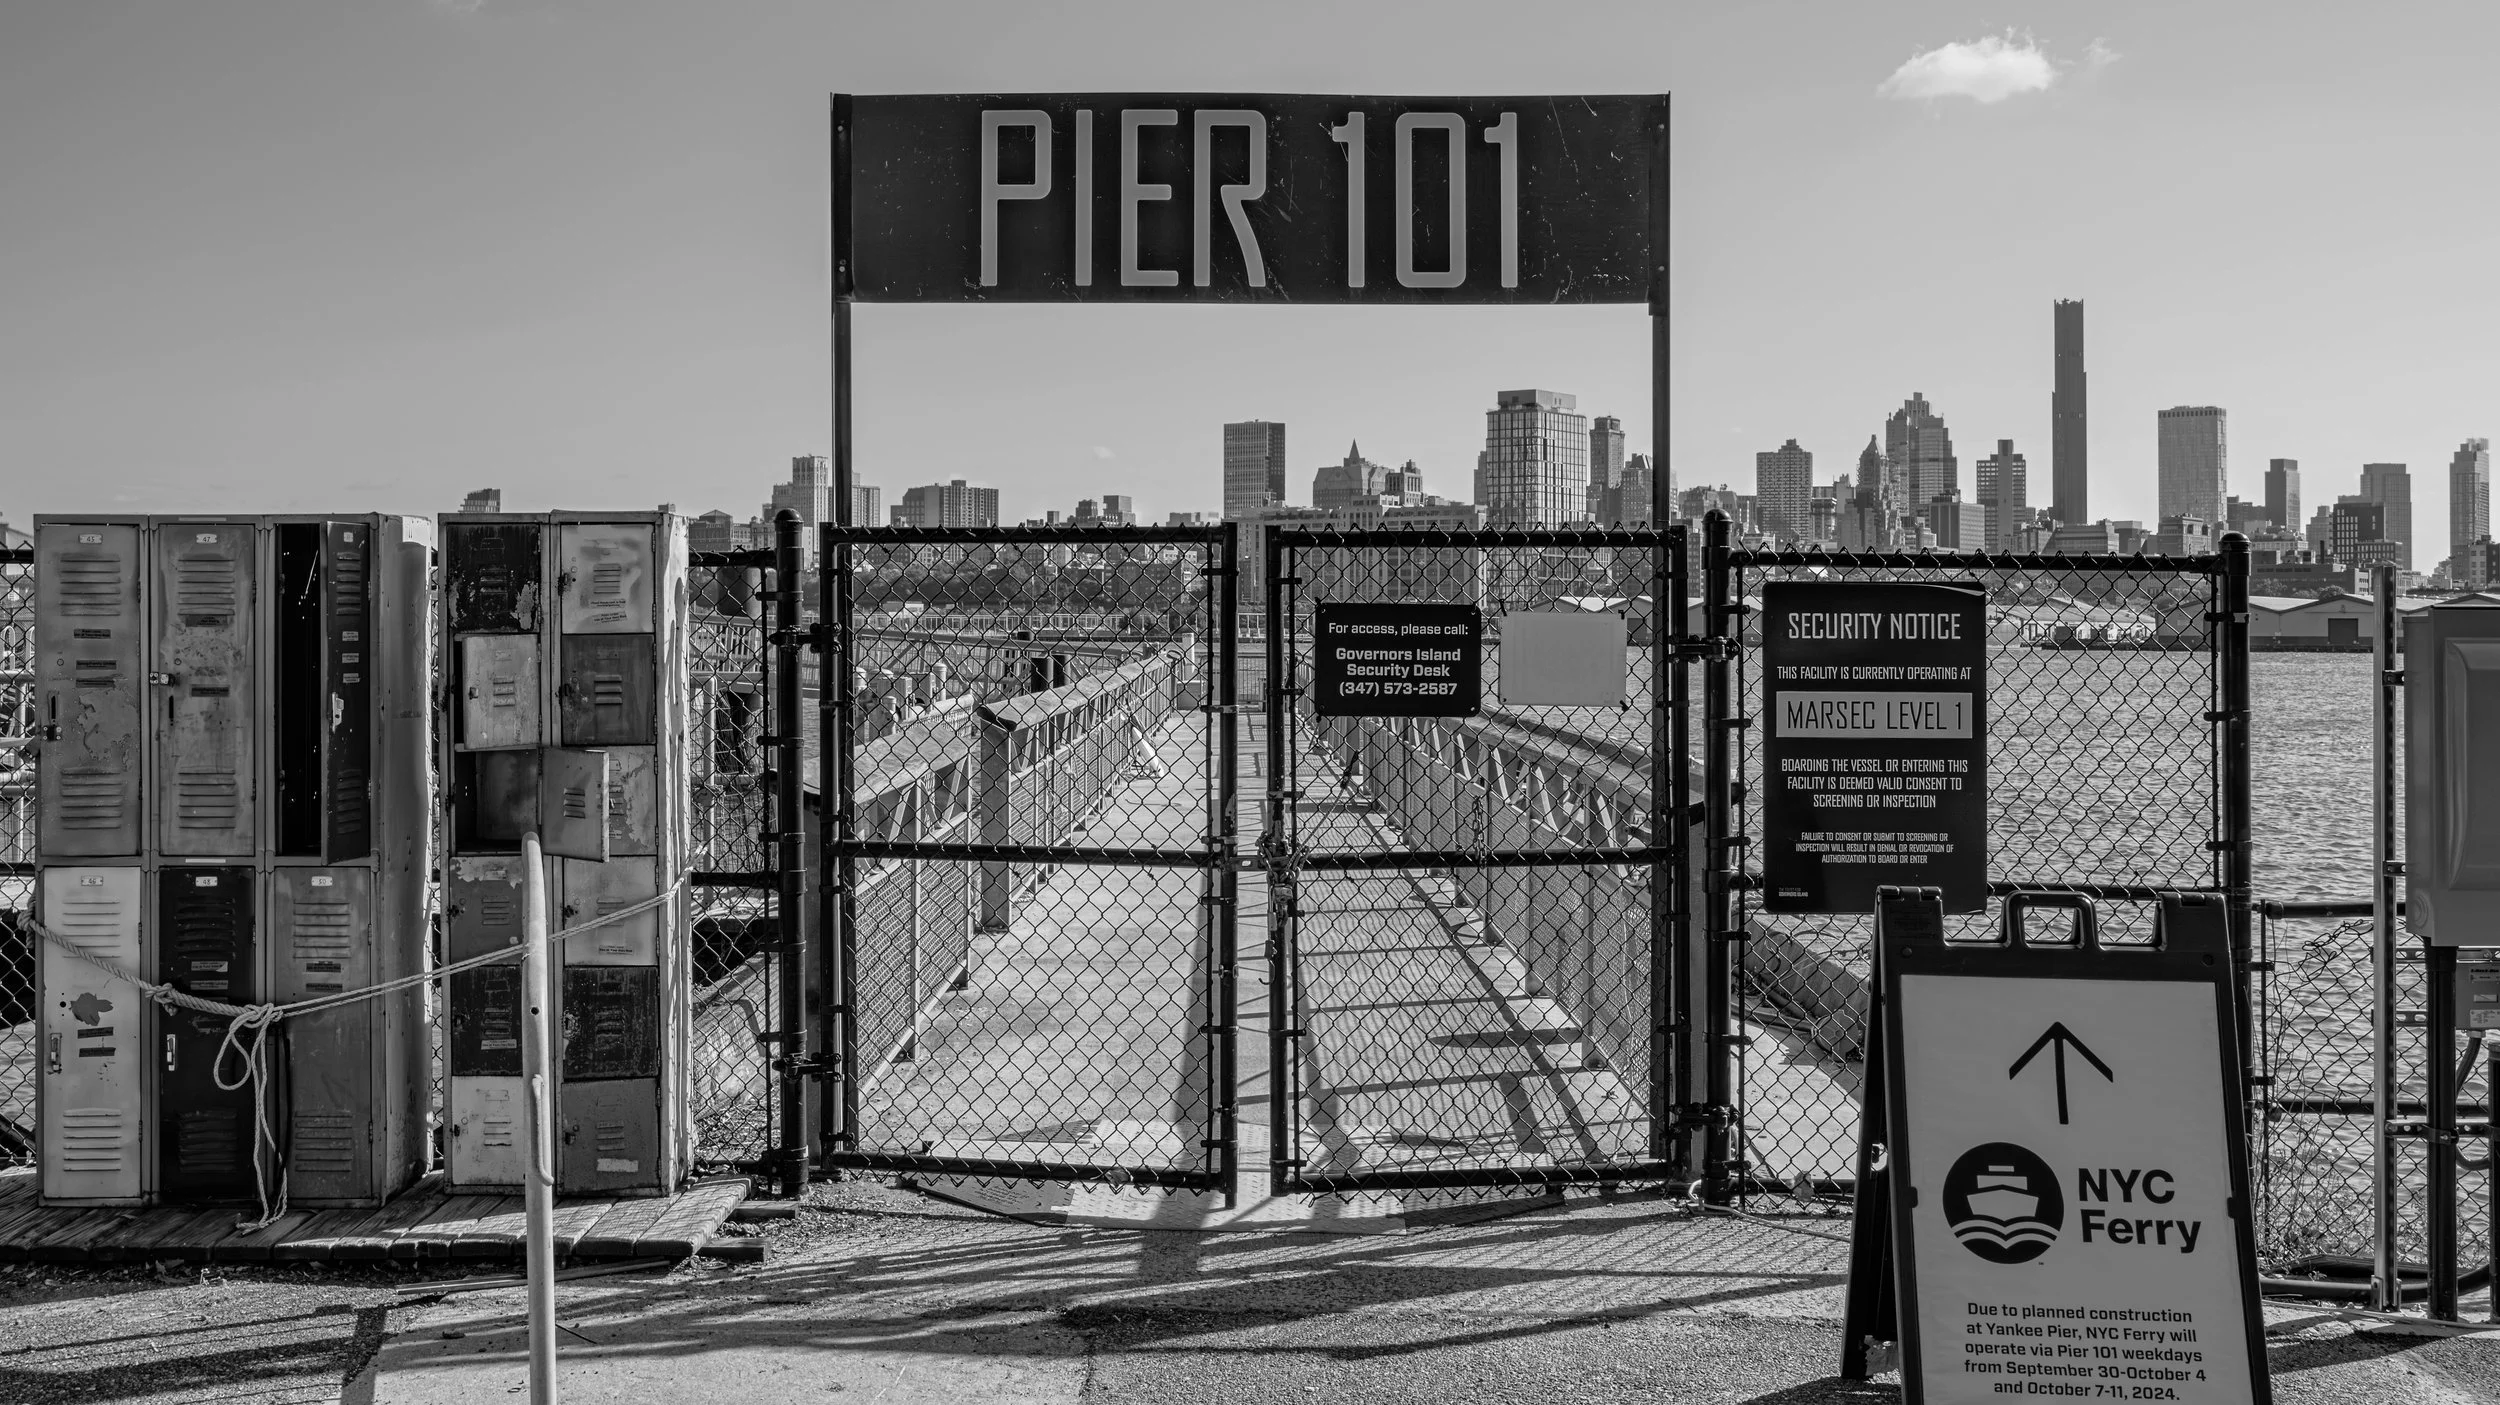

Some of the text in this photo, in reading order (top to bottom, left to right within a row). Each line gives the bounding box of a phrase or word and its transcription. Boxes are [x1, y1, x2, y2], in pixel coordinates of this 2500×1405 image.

[979, 107, 1518, 288] PIER 101
[86, 535, 95, 543] 45
[1329, 623, 1468, 636] For access, please call:
[1789, 613, 1960, 639] SECURITY NOTICE
[1336, 648, 1460, 661] Governors Island
[1347, 664, 1450, 678] Security Desk
[1777, 666, 1971, 679] THIS FACILITY IS CURRENTLY OPERATING AT
[1340, 682, 1457, 696] (347) 573-2587
[1788, 701, 1961, 729] MARSEC LEVEL 1
[1782, 759, 1967, 772] BOARDING THE VESSEL OR ENTERING THIS
[1788, 777, 1961, 790] FACILITY IS DEEMED VALID CONSENT TO
[1814, 795, 1935, 807] SCREENING OR INSPECTION
[1802, 832, 1948, 841] FAILURE TO CONSENT OR SUBMIT TO SCREENING OR
[1796, 843, 1953, 852] INSPECTION WILL RESULT IN DENIAL OR REVOCATION OF
[1822, 855, 1927, 863] AUTHORIZATION TO BOARD OR ENTER
[88, 877, 97, 886] 46
[318, 878, 327, 886] 50
[2079, 1168, 2174, 1204] NYC
[2081, 1209, 2201, 1253] Ferry
[1968, 1303, 2192, 1322] Due to planned construction
[1967, 1323, 2196, 1343] at Yankee Pier, NYC Ferry will
[1966, 1344, 2202, 1364] operate via Pier 101 weekdays
[1965, 1360, 2206, 1381] from September 30-October 4
[1995, 1381, 2179, 1400] and October 7-11, 2024.
